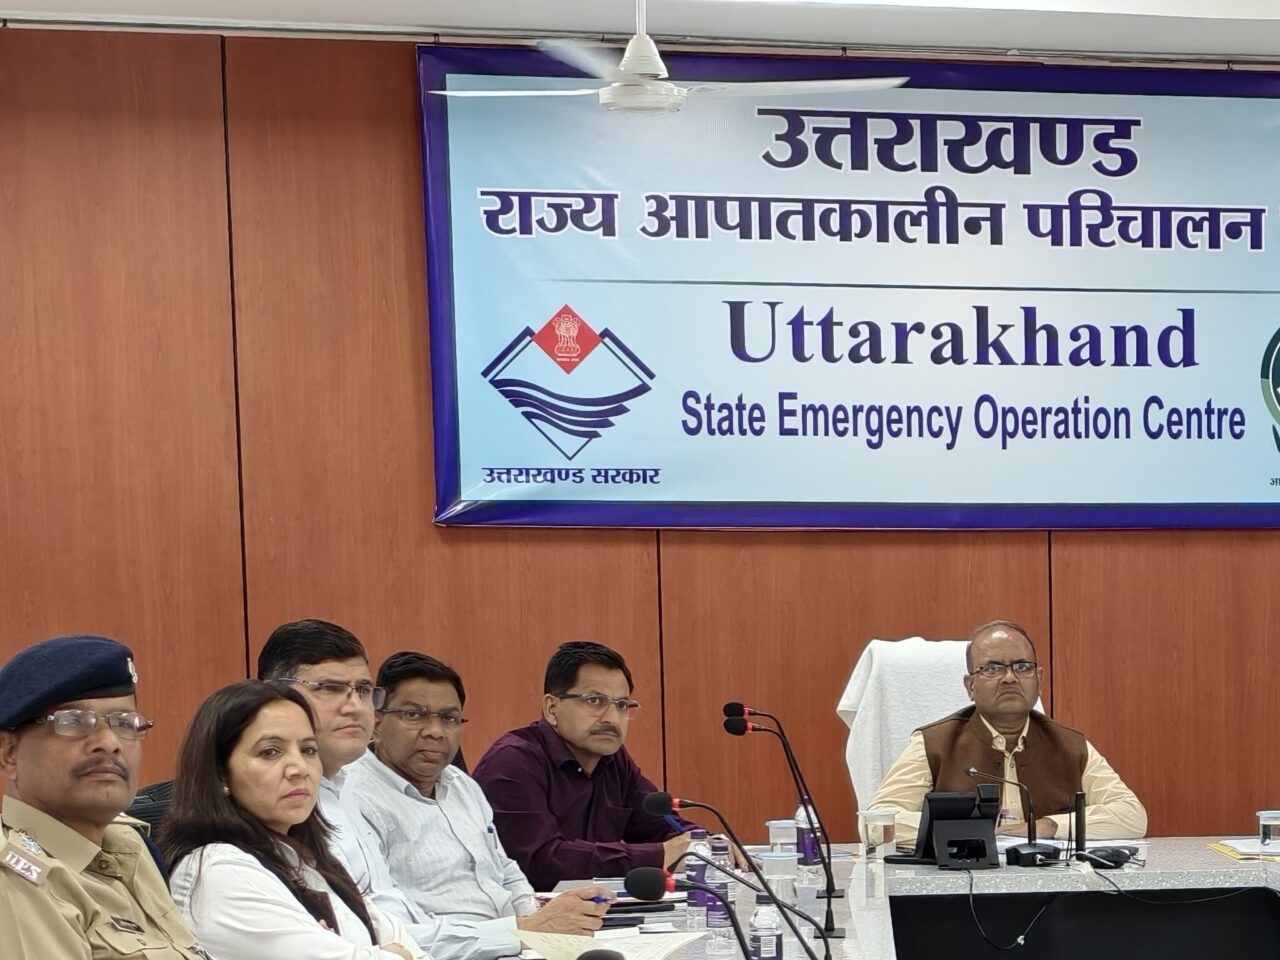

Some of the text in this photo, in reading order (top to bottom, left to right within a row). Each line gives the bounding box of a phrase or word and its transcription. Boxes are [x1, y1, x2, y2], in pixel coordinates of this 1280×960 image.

[756, 107, 1142, 178] उत्तराखण्ड
[478, 189, 618, 237] राज्य
[639, 185, 1005, 246] आपातकालीन
[1022, 188, 1266, 250] परिचालन
[721, 300, 1200, 369] Uttarakhand
[681, 390, 1246, 451] State Emergency Operation Centre
[482, 467, 662, 484] उत्तराखण्ड सरकार
